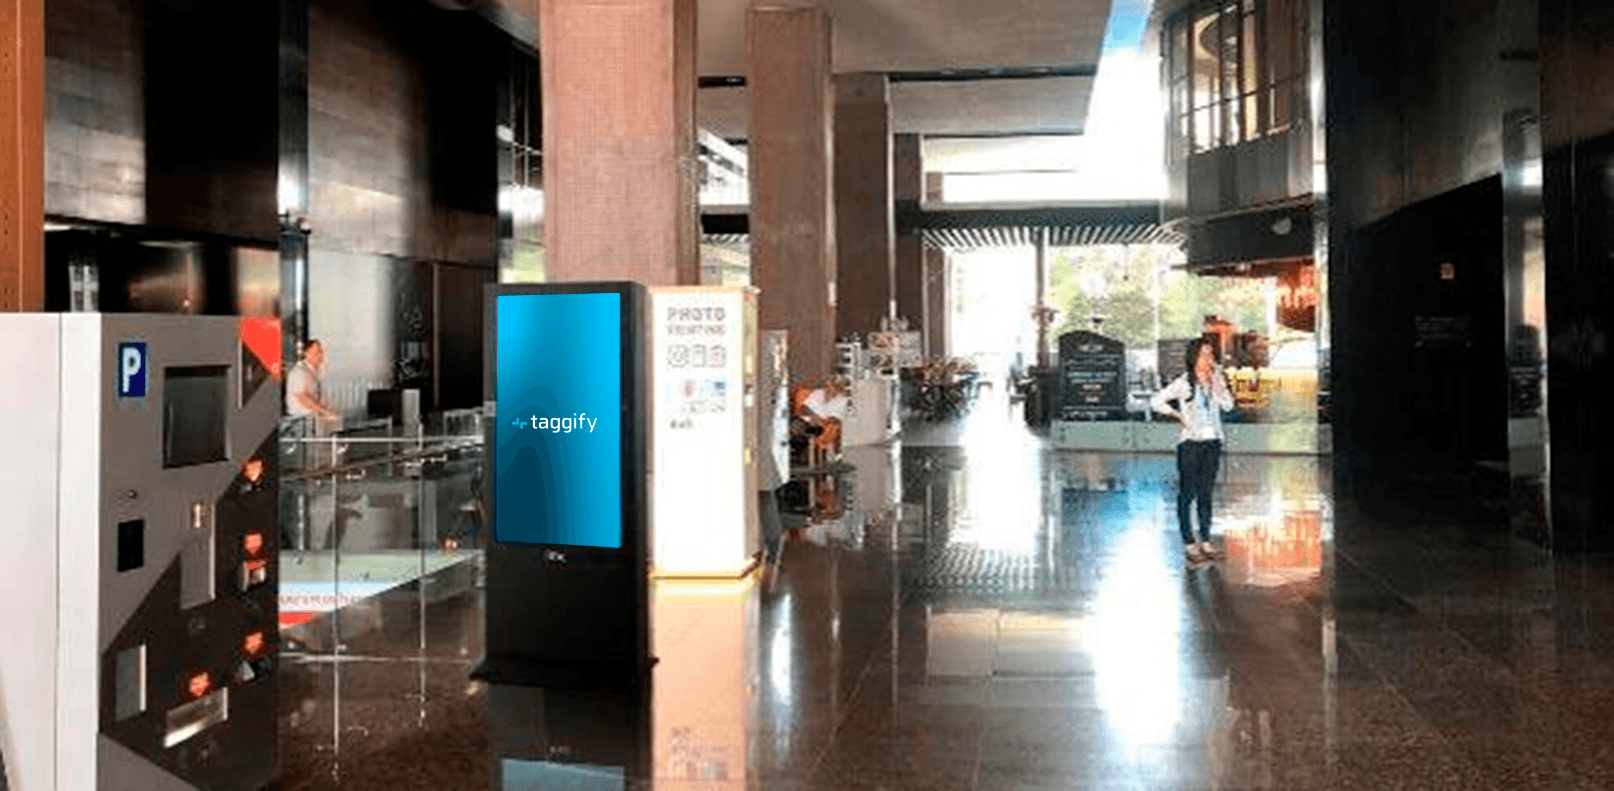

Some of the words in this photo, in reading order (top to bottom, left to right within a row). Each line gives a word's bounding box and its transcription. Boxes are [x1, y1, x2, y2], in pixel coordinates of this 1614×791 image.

[667, 307, 726, 321] PHOTO
[122, 347, 141, 393] P
[530, 413, 598, 434] taggify
